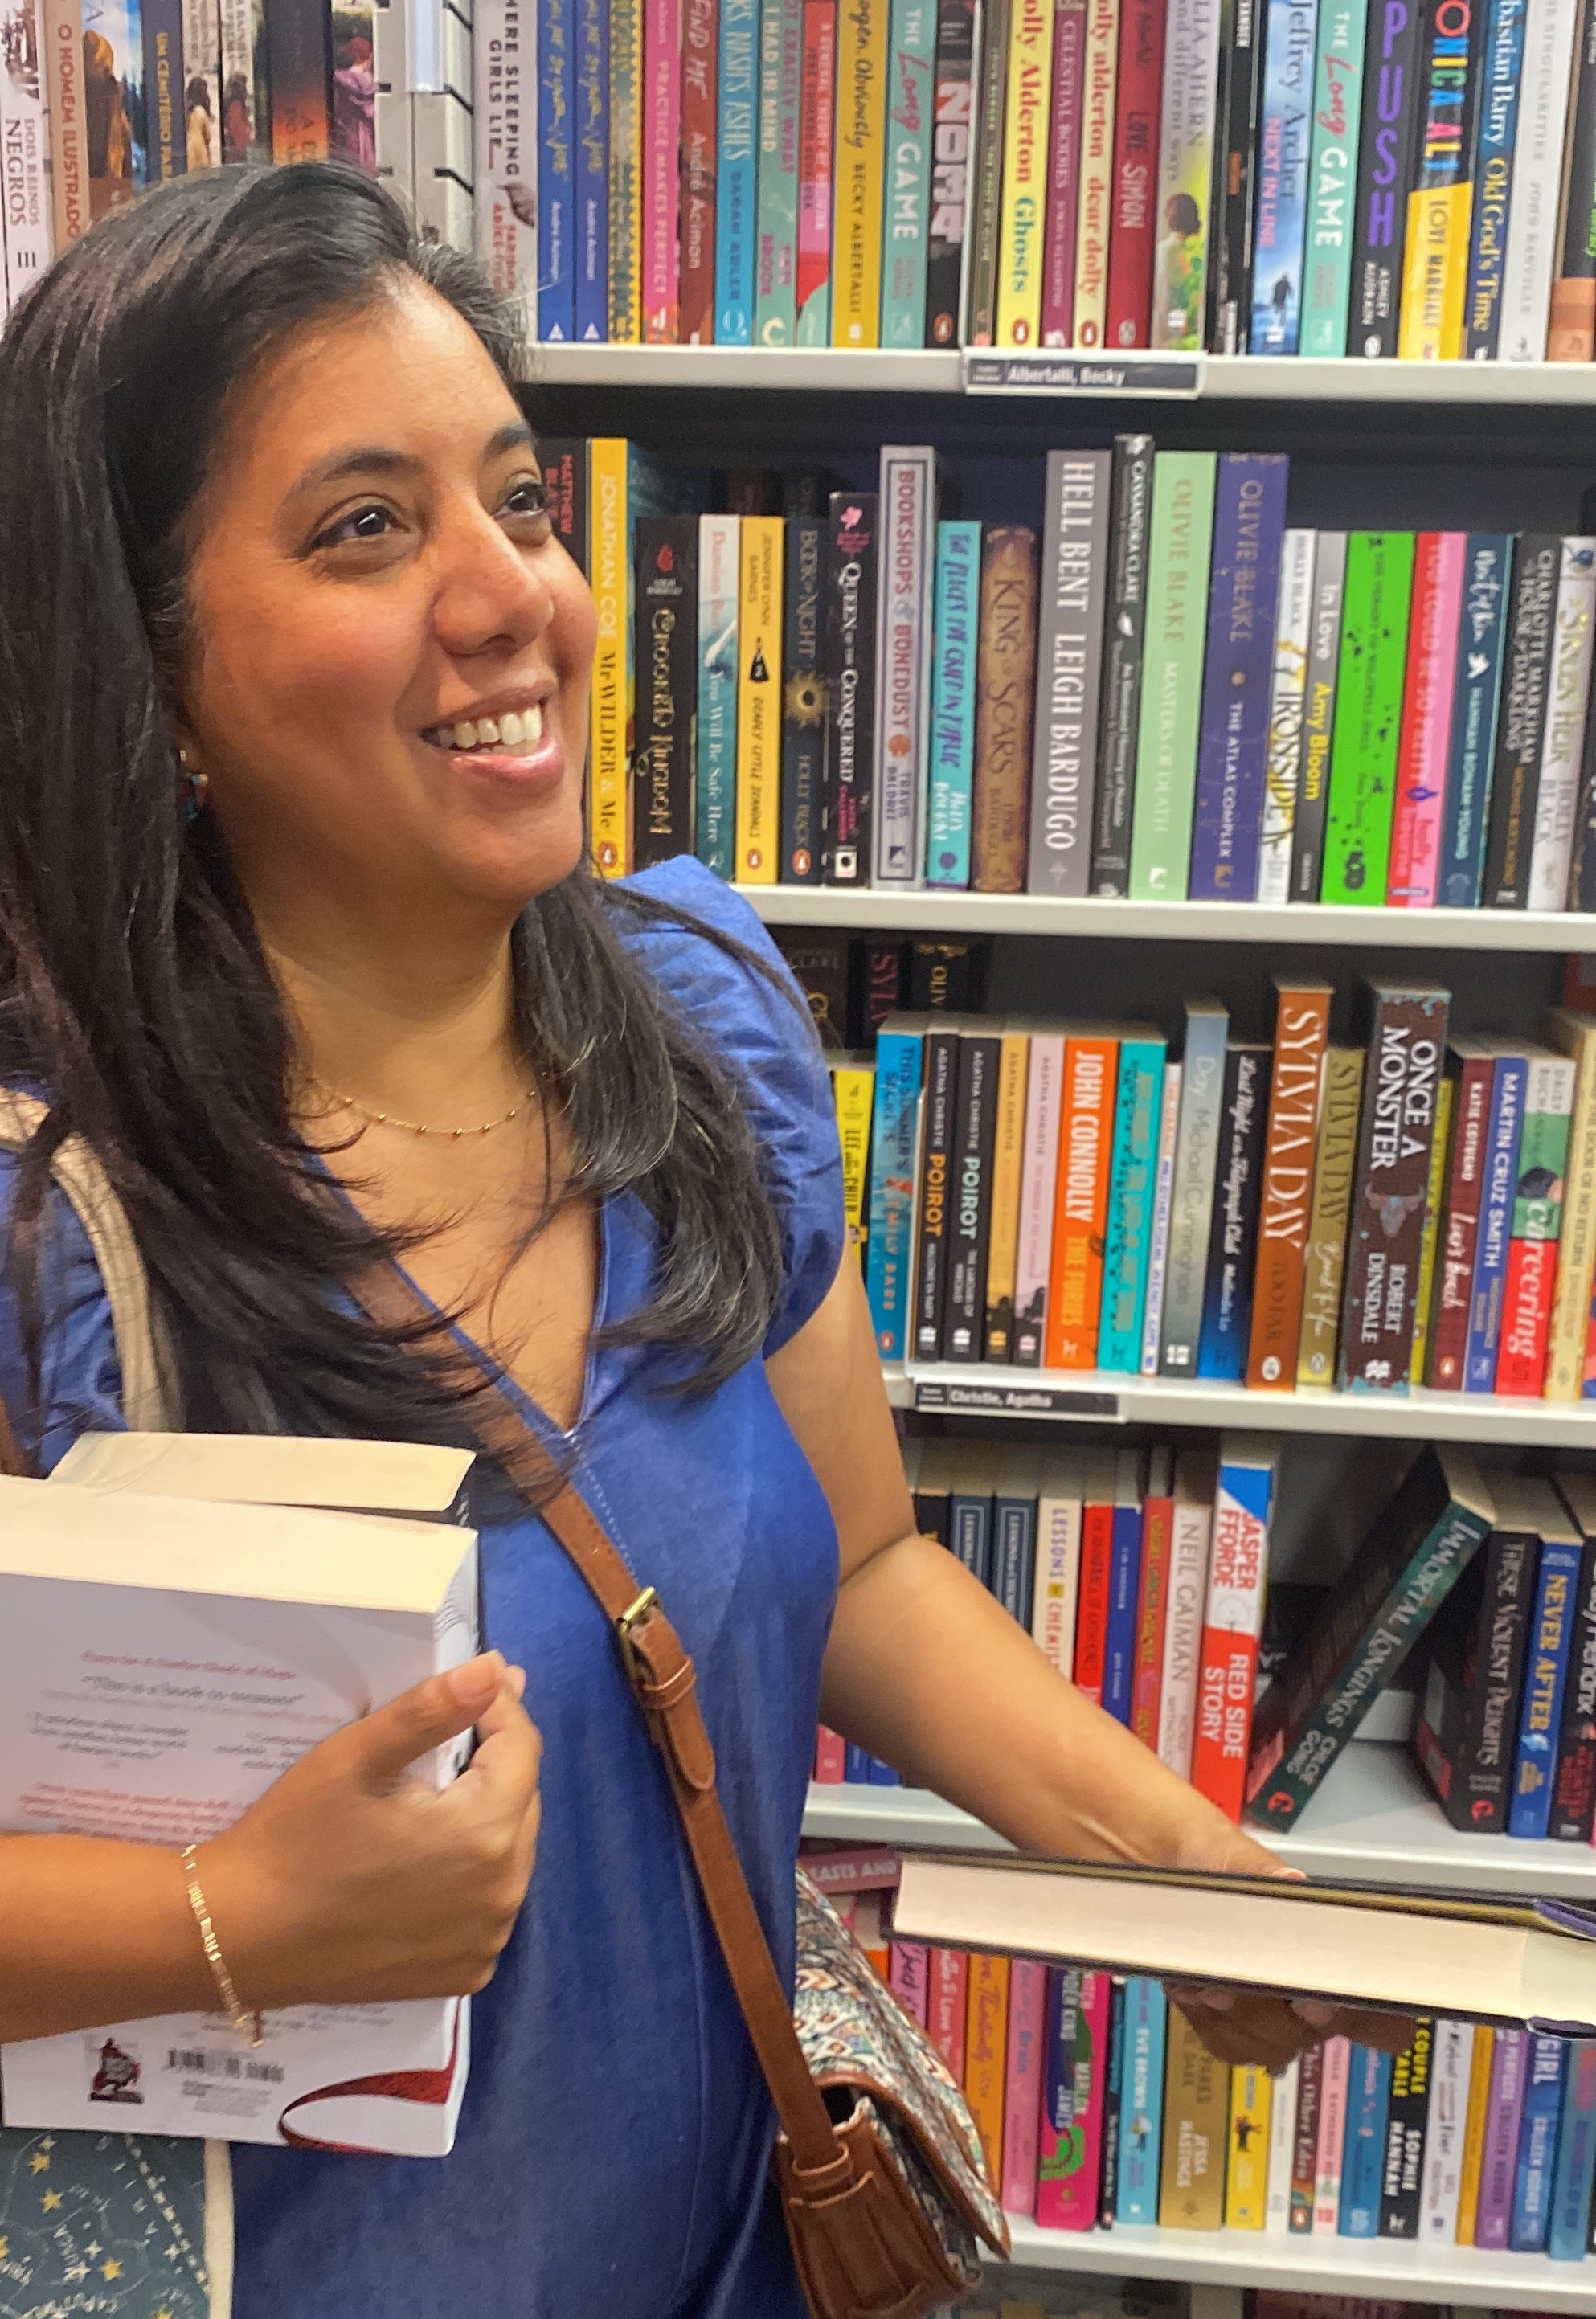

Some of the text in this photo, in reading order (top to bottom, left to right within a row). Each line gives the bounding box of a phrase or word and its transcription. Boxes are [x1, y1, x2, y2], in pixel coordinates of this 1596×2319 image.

[156, 32, 169, 56] UM
[904, 8, 922, 45] THE
[1332, 11, 1350, 50] THE
[59, 24, 80, 239] O HOMEM ILUSTRADO
[488, 39, 503, 149] GIRLS LIE
[505, 64, 520, 175] SLEEPING
[761, 20, 778, 153] HAD IN MIND
[891, 50, 931, 133] Long
[1054, 20, 1077, 189] CELESTIAL BODIES
[1167, 39, 1190, 182] different ways
[1186, 55, 1207, 148] AHERN
[1281, 0, 1313, 202] Jeffrey Archer
[1317, 54, 1357, 135] Long
[1369, 2, 1408, 247] PUSH
[6, 118, 26, 227] NEGROS
[24, 118, 39, 226] DOIS REINOS
[781, 117, 796, 174] WHAT
[843, 59, 875, 215] Obviously BECKY
[1011, 59, 1041, 293] Alderton Ghosts
[1078, 51, 1112, 296] alderton dear dolly
[1260, 118, 1282, 247] NEXT IN LINE
[1424, 121, 1463, 171] ALI
[689, 132, 706, 269] André Aciman
[892, 141, 922, 241] GAME
[1119, 162, 1148, 229] SIMON
[1314, 145, 1348, 247] GAME
[1426, 200, 1447, 245] LOVE
[1473, 84, 1516, 332] Barry Old God's Time
[1376, 268, 1391, 318] ASHLEY
[1126, 461, 1147, 552] CASSANDRA
[892, 469, 917, 727] BOOKSHOPS BONEDUST
[1164, 479, 1192, 643] OLIVIE BLAKE
[600, 473, 617, 829] JONATHAN COE Mr WILDER Me
[796, 530, 816, 799] BOOK NIGHT HOLLY
[837, 562, 864, 782] QUEEN CONQUERED
[987, 579, 1026, 775] KING SCARS
[1044, 461, 1096, 850] HELL BENT LEIGH BARDUGO
[1218, 479, 1262, 857] OLIVIE BLAKE THE ATLAS COMPLEX
[1304, 583, 1338, 800] In Love Amy Bloom
[707, 670, 726, 843] You Will Be Safe Here
[898, 770, 911, 819] TRAVIS
[900, 1046, 915, 1082] THIS
[1038, 1056, 1052, 1103] AGATHA
[1324, 1061, 1359, 1160] SYLVIA
[1369, 1025, 1409, 1169] MONSTER
[1403, 1040, 1437, 1127] ONCE
[1549, 1067, 1567, 1111] DAISY
[845, 1130, 861, 1150] LEE
[924, 1047, 948, 1237] AGATHA CHRISTIE POIROT
[959, 1051, 983, 1239] AGATHA CHRISTIE POIROT
[1035, 1106, 1050, 1155] CHRISTIE
[1232, 1095, 1257, 1135] Night
[1262, 1008, 1323, 1249] SYLVIA DAY
[1398, 1134, 1424, 1159] A
[1460, 1082, 1484, 1181] KATIE COTUGNO
[843, 1177, 861, 1213] CHILD
[1062, 1050, 1105, 1326] JOHN CONNOLLY THE FURIES
[1173, 1054, 1217, 1307] Day Michael Cunningham
[1318, 1170, 1348, 1226] DAY
[1483, 1072, 1518, 1268] MARTIN CRUZ SMITH
[1361, 1252, 1386, 1344] DINSDALE
[1381, 1264, 1407, 1335] ROBERT
[1507, 1200, 1554, 1360] careering
[1048, 1508, 1067, 1578] LESSONS
[1213, 1509, 1240, 1589] FFORDE
[1236, 1513, 1262, 1589] JASPER
[1170, 1524, 1200, 1683] NEIL GAIMAN
[1324, 1520, 1481, 1729] IMMORTAL LONGINGS
[1539, 1574, 1569, 1650] NEVER
[1201, 1666, 1224, 1742] STORY
[1222, 1653, 1249, 1758] RED SIDE
[1529, 1657, 1558, 1731] AFTER
[1134, 2028, 1149, 2109] EVE BROWN
[1410, 2029, 1430, 2094] COUPLE
[1532, 2038, 1560, 2085] GIRL
[1176, 2120, 1194, 2188] HASTINGS
[1193, 2133, 1209, 2175] JESSA
[1384, 2120, 1406, 2197] HANNAH
[1402, 2129, 1421, 2192] SOPHIE
